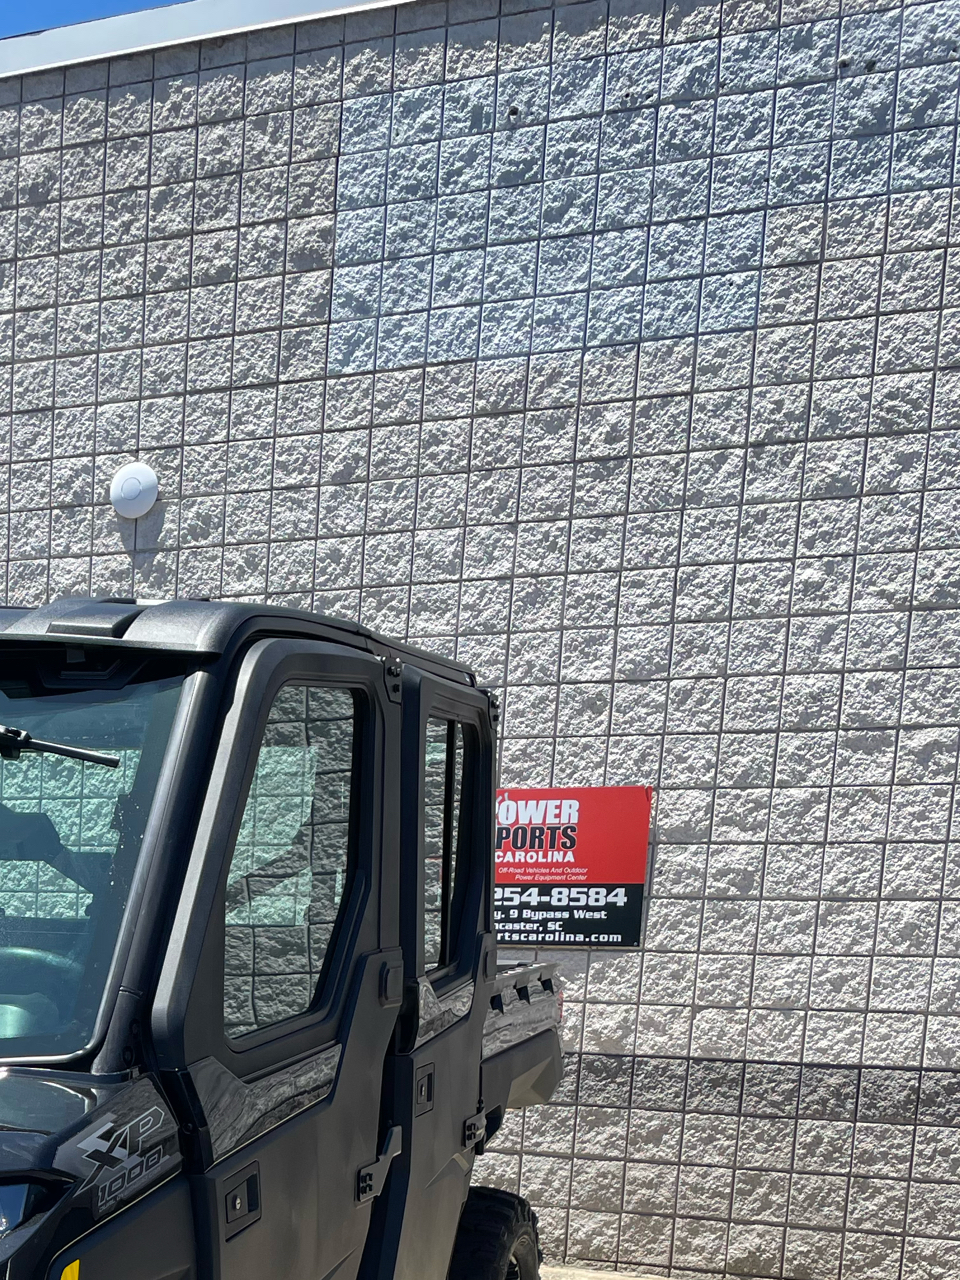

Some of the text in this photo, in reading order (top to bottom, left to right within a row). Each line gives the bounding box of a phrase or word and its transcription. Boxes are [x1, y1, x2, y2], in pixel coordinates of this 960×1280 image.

[496, 799, 580, 825] OWER
[495, 824, 578, 851] PORTS
[494, 851, 575, 863] CAROLINA
[534, 874, 566, 882] Equipment
[494, 909, 608, 920] y. 9 Bypass West
[494, 921, 564, 931] ncaster, SC
[496, 931, 622, 942] rtscarolina.com
[72, 1106, 165, 1198] XP
[98, 1145, 163, 1206] 1000
